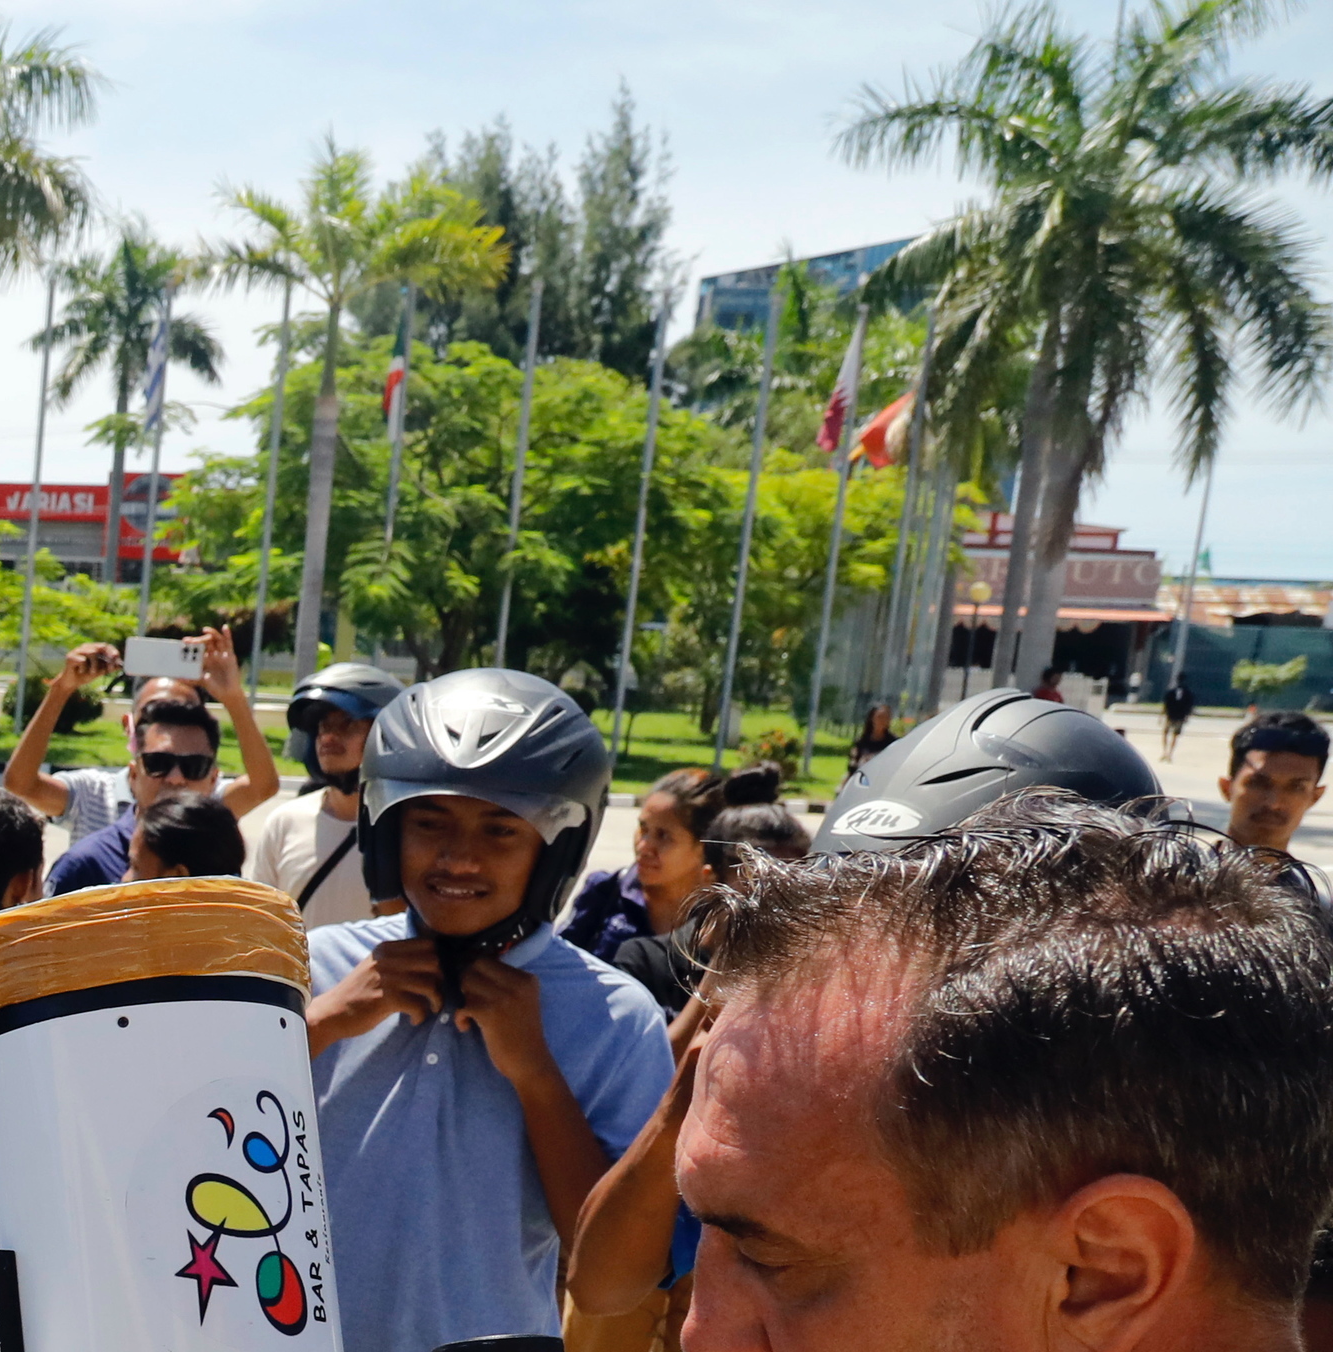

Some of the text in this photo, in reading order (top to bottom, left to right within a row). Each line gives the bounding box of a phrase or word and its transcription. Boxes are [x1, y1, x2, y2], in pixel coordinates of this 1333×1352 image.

[292, 1110, 328, 1323] BAR & TAPAS
